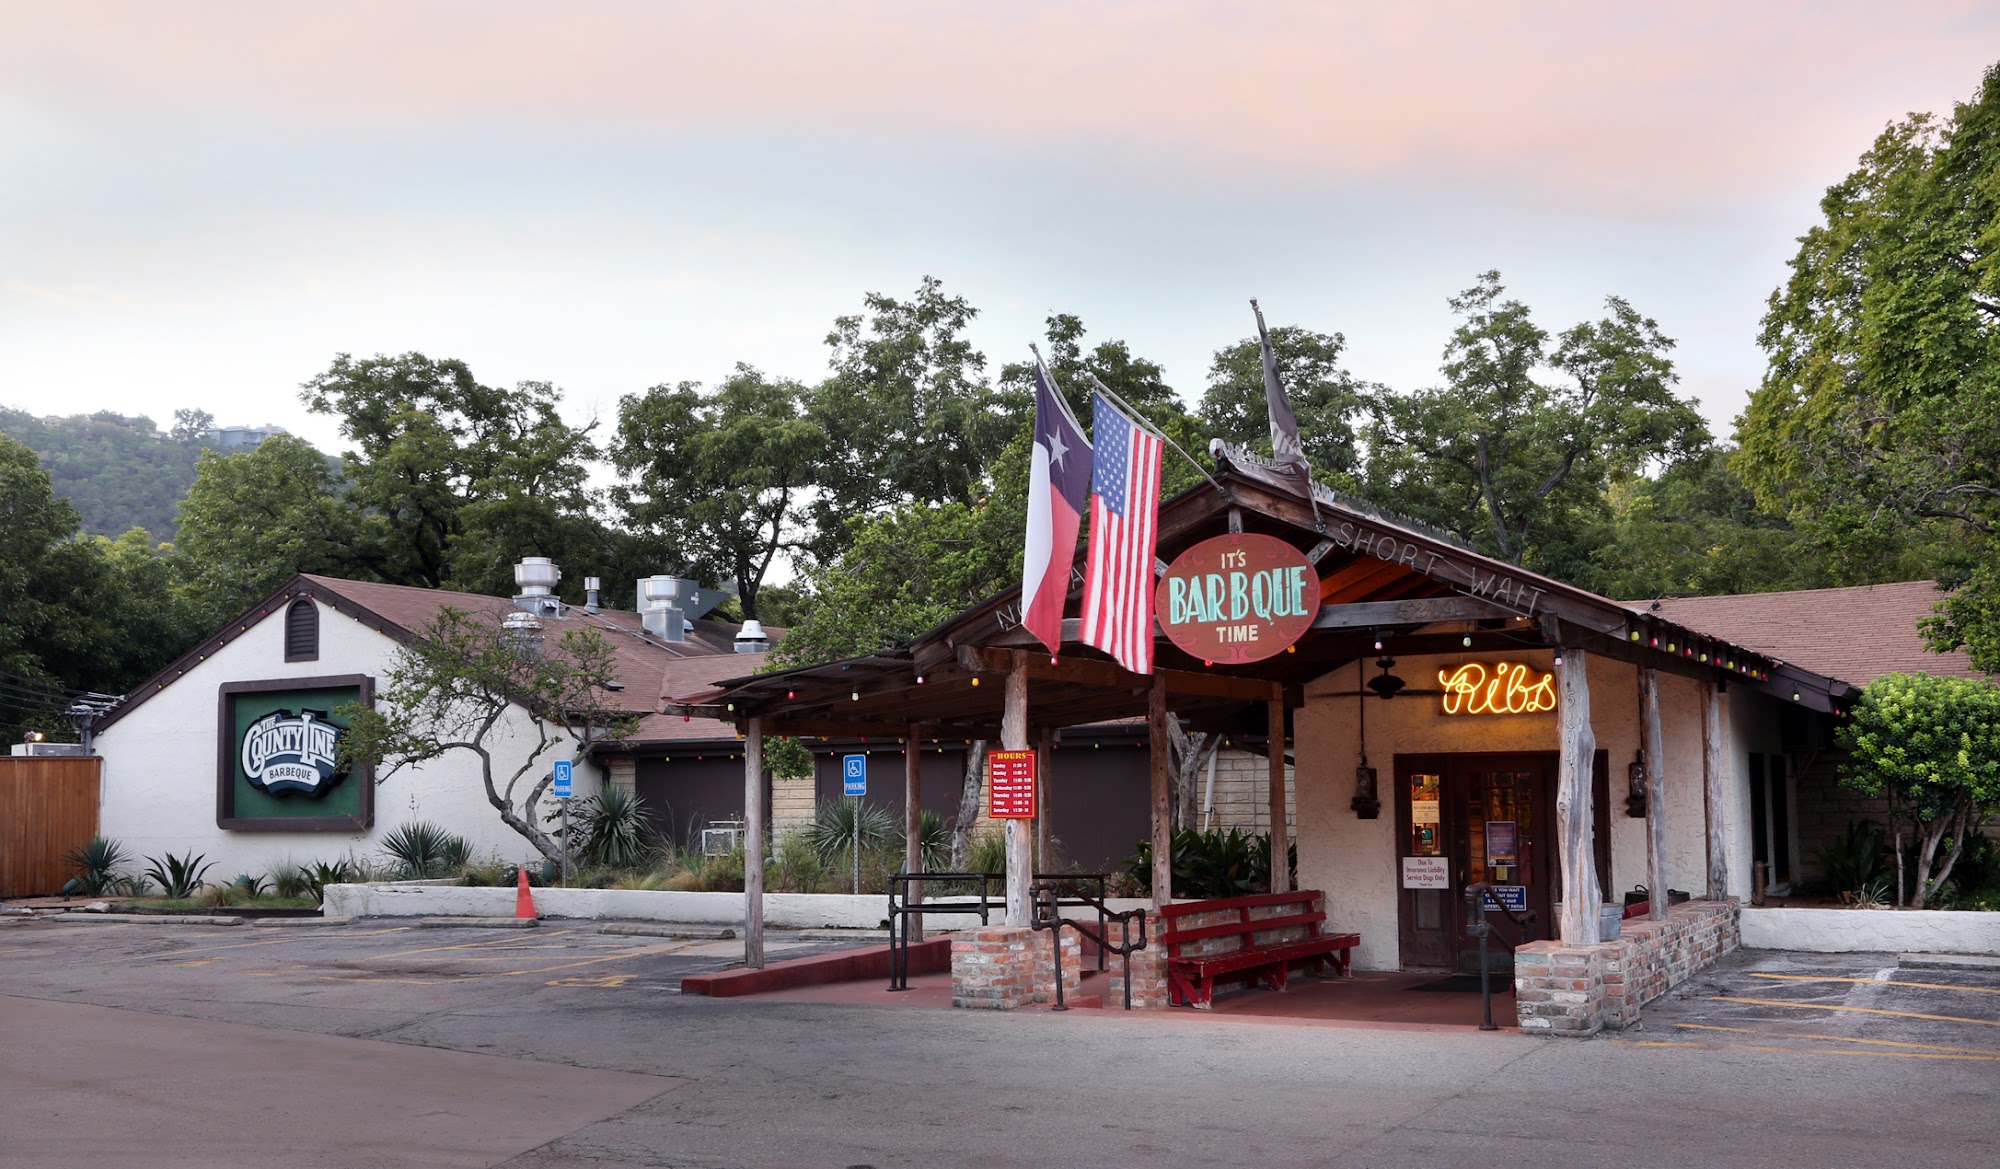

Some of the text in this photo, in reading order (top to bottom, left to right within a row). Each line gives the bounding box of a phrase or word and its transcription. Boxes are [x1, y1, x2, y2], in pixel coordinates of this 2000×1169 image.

[1221, 549, 1246, 569] IT'S
[1336, 522, 1547, 618] SHORT WAIT
[1399, 600, 1458, 620] 5204
[1216, 625, 1258, 643] TIME
[1439, 663, 1556, 713] Ribs
[261, 716, 276, 731] THE
[242, 714, 336, 779] COUNTY LINE
[269, 767, 312, 781] BARBEQUE
[845, 782, 865, 790] PARKING
[1423, 874, 1434, 882] Dogs
